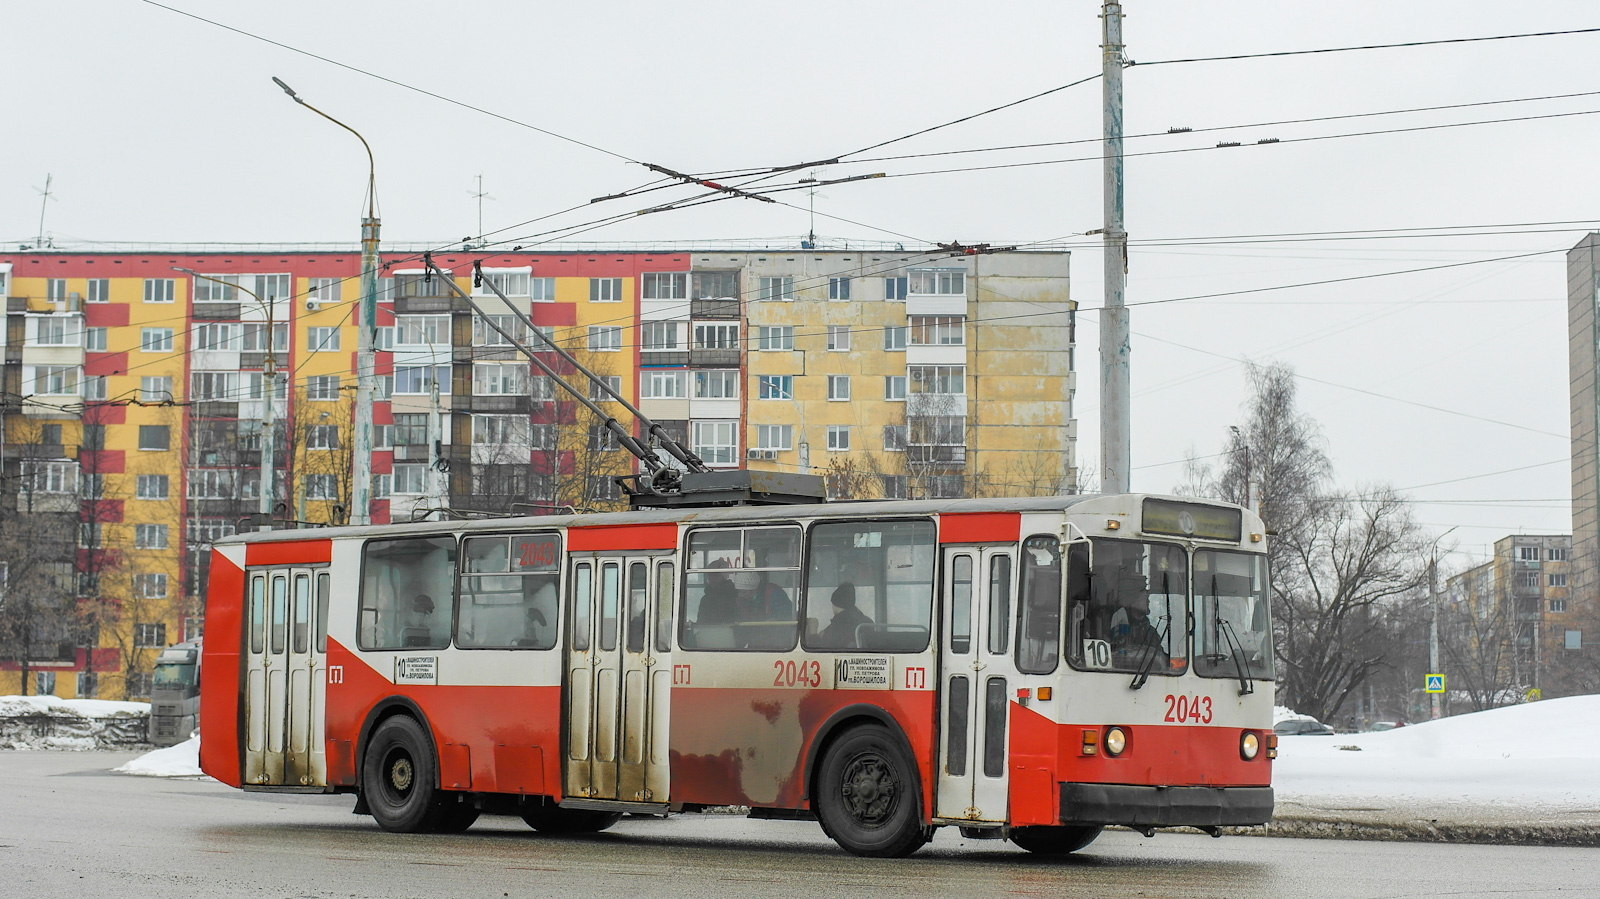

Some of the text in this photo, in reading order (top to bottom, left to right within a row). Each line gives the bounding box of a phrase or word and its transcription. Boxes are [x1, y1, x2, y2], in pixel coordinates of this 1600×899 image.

[519, 542, 555, 566] 2043
[1087, 640, 1109, 666] 10
[398, 658, 406, 678] 10
[773, 660, 821, 688] 2043
[838, 659, 849, 682] 10
[1164, 694, 1212, 724] 2043
